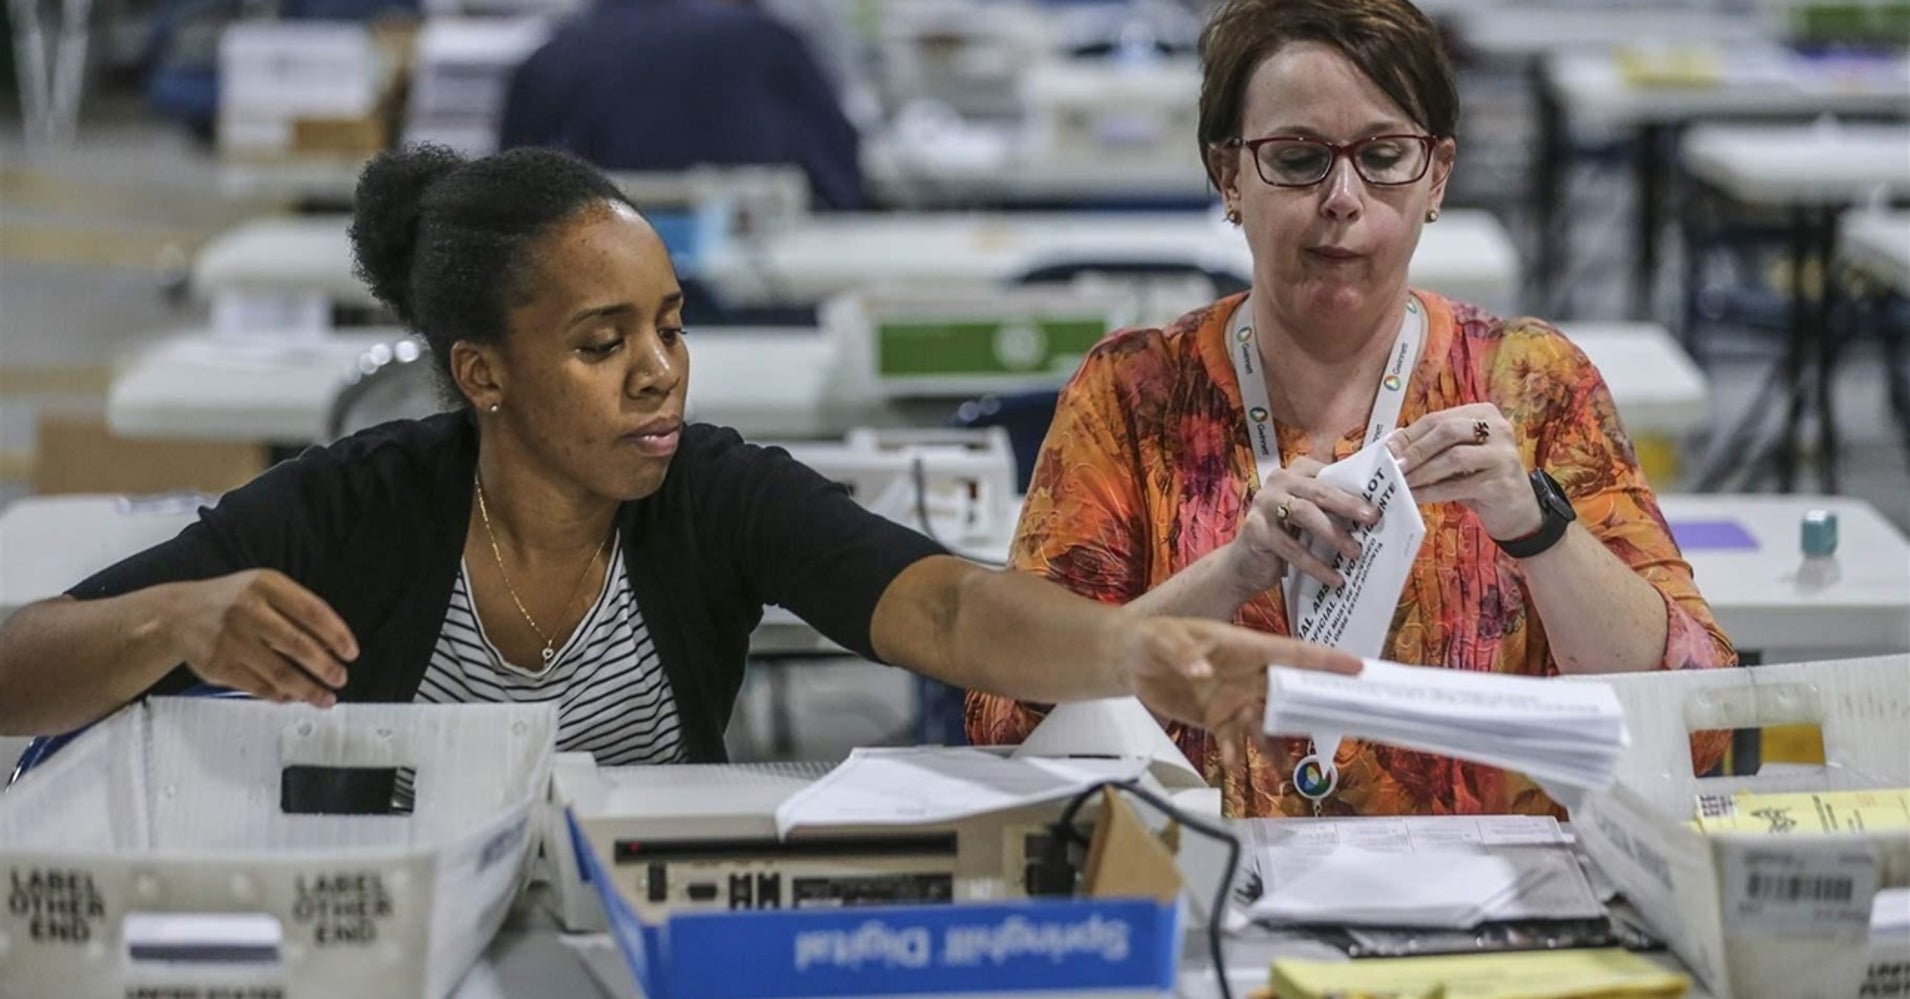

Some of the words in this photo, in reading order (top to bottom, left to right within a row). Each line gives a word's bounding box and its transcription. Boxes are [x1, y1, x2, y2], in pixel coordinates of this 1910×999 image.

[1257, 424, 1269, 456] Gwinnett
[1330, 602, 1347, 630] MUST
[10, 868, 97, 898] LABEL
[294, 872, 386, 899] LABEL
[8, 891, 105, 918] OTHER
[293, 894, 393, 922] OTHER
[30, 917, 91, 943] END
[315, 919, 377, 944] END
[945, 913, 1130, 963] Springhill
[794, 919, 930, 971] Digital
